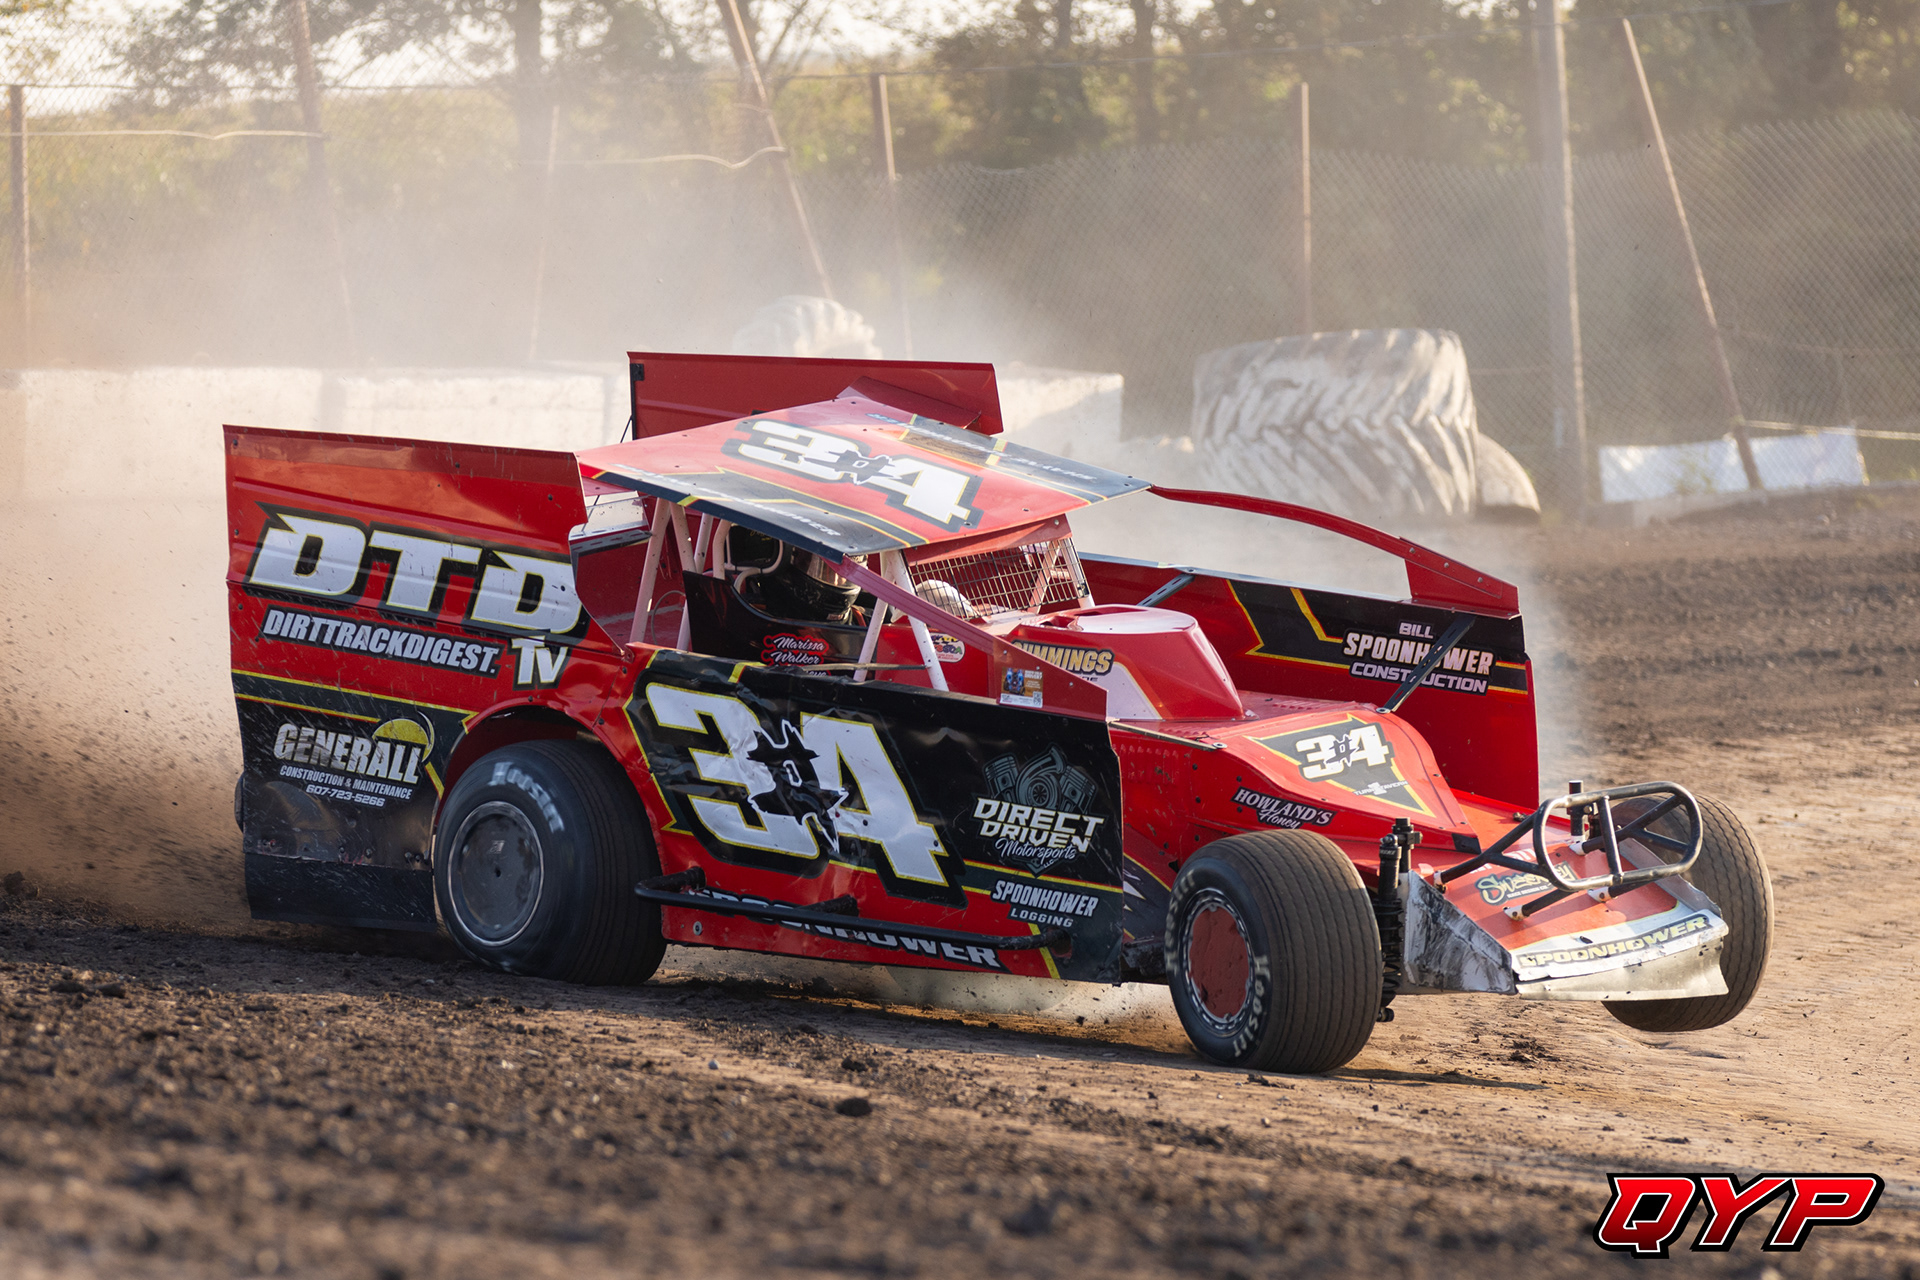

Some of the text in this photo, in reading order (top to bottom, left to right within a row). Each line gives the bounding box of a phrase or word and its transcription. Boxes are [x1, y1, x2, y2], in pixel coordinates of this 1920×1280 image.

[250, 513, 583, 635] DTD
[263, 609, 569, 685] DIRTTRACKDIGEST. TV
[773, 636, 825, 651] Marissa
[1399, 622, 1434, 639] BILL
[770, 651, 820, 664] Walker
[273, 723, 422, 785] GENERALL
[1295, 724, 1389, 779] 34
[279, 764, 413, 800] CONSTRUCTION & MAINTENANCE
[305, 783, 386, 808] 607-723-5266
[645, 681, 950, 887] 34
[973, 797, 1105, 837] DIRECT
[1234, 788, 1333, 824] HOWLAND'S
[1259, 809, 1301, 830] Honey
[979, 819, 1091, 853] DRIVEN
[994, 837, 1077, 865] Motorsports
[992, 880, 1099, 917] SPOONHOWER
[1010, 907, 1074, 928] LOGGING
[1519, 916, 1706, 967] SPOONHOWER
[1232, 955, 1271, 1058] Hoosier
